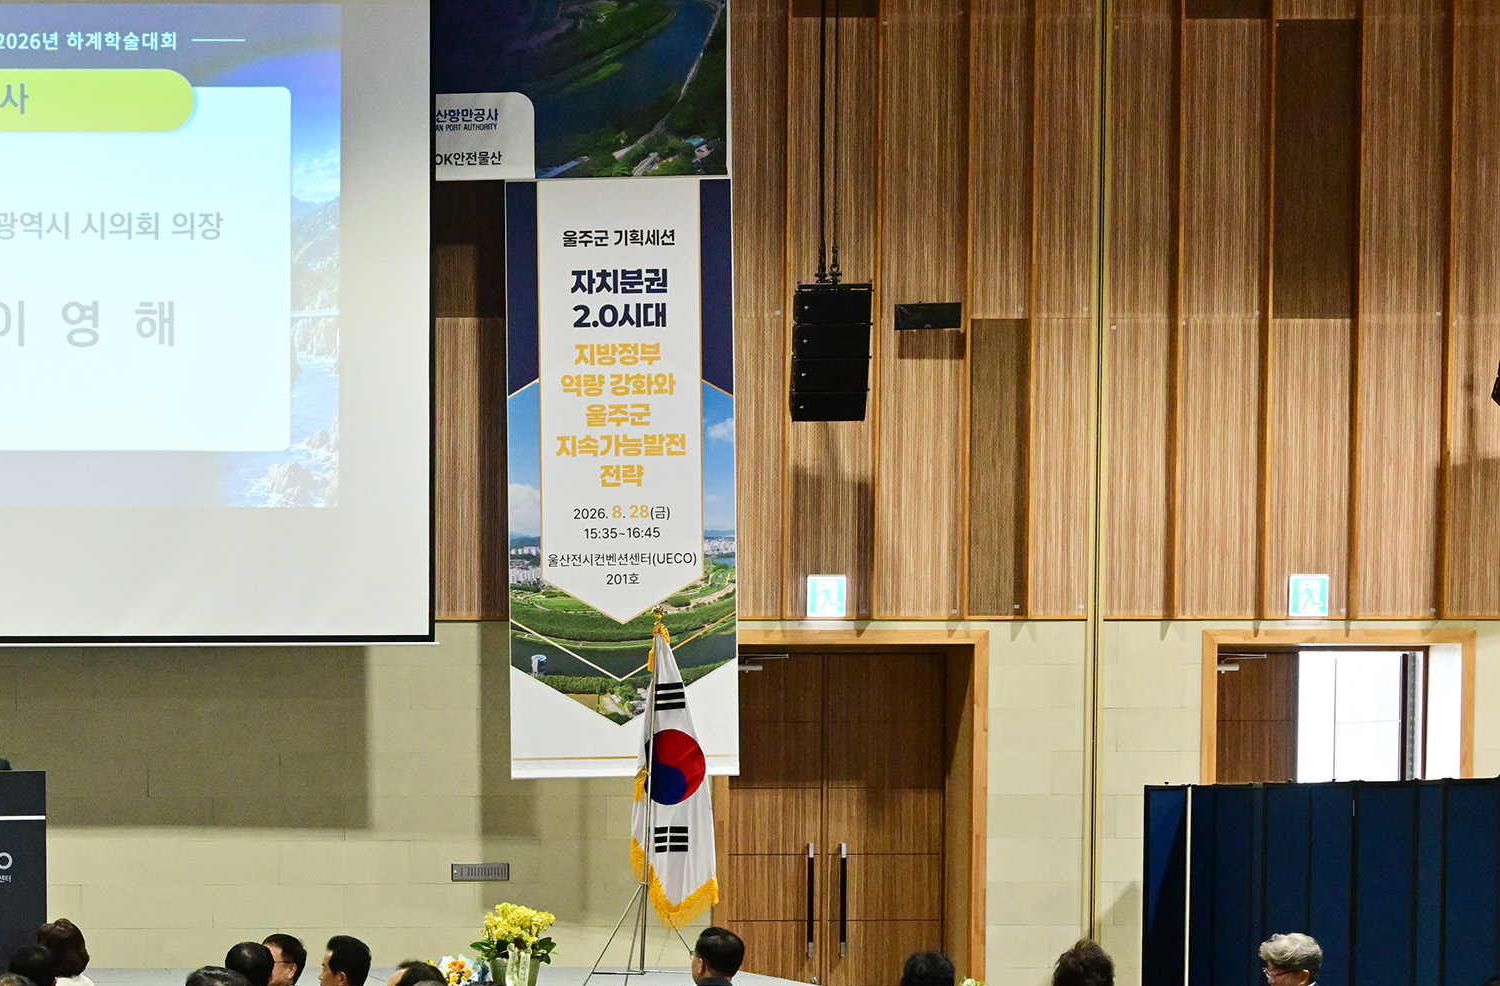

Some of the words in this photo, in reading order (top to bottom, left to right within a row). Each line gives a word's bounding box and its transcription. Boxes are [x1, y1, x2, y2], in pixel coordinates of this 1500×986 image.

[66, 31, 177, 51] 하계학술대회
[436, 108, 498, 122] 산항만공사
[445, 123, 462, 131] PORT
[463, 122, 499, 131] AUTHORITY
[435, 150, 503, 166] OK안전물산
[81, 211, 160, 241] 시의회
[171, 211, 224, 241] 의장
[562, 229, 610, 248] 울주군
[613, 228, 676, 247] 기획세션
[570, 268, 668, 295] 자치분권
[61, 300, 100, 348] 영
[134, 300, 175, 348] 해
[572, 302, 667, 328] 2.0시대
[574, 342, 662, 367] 지방정부
[560, 373, 606, 398] 역량
[609, 372, 677, 397] 강화와
[585, 403, 652, 428] 울주군
[556, 433, 687, 458] 지속가능발전
[599, 464, 645, 488] 전략
[573, 507, 609, 520] 2026.
[583, 526, 661, 540] 15:35~16:45
[547, 551, 698, 568] 울산전시컨벤션센터(UECO)
[606, 572, 640, 586] 201호
